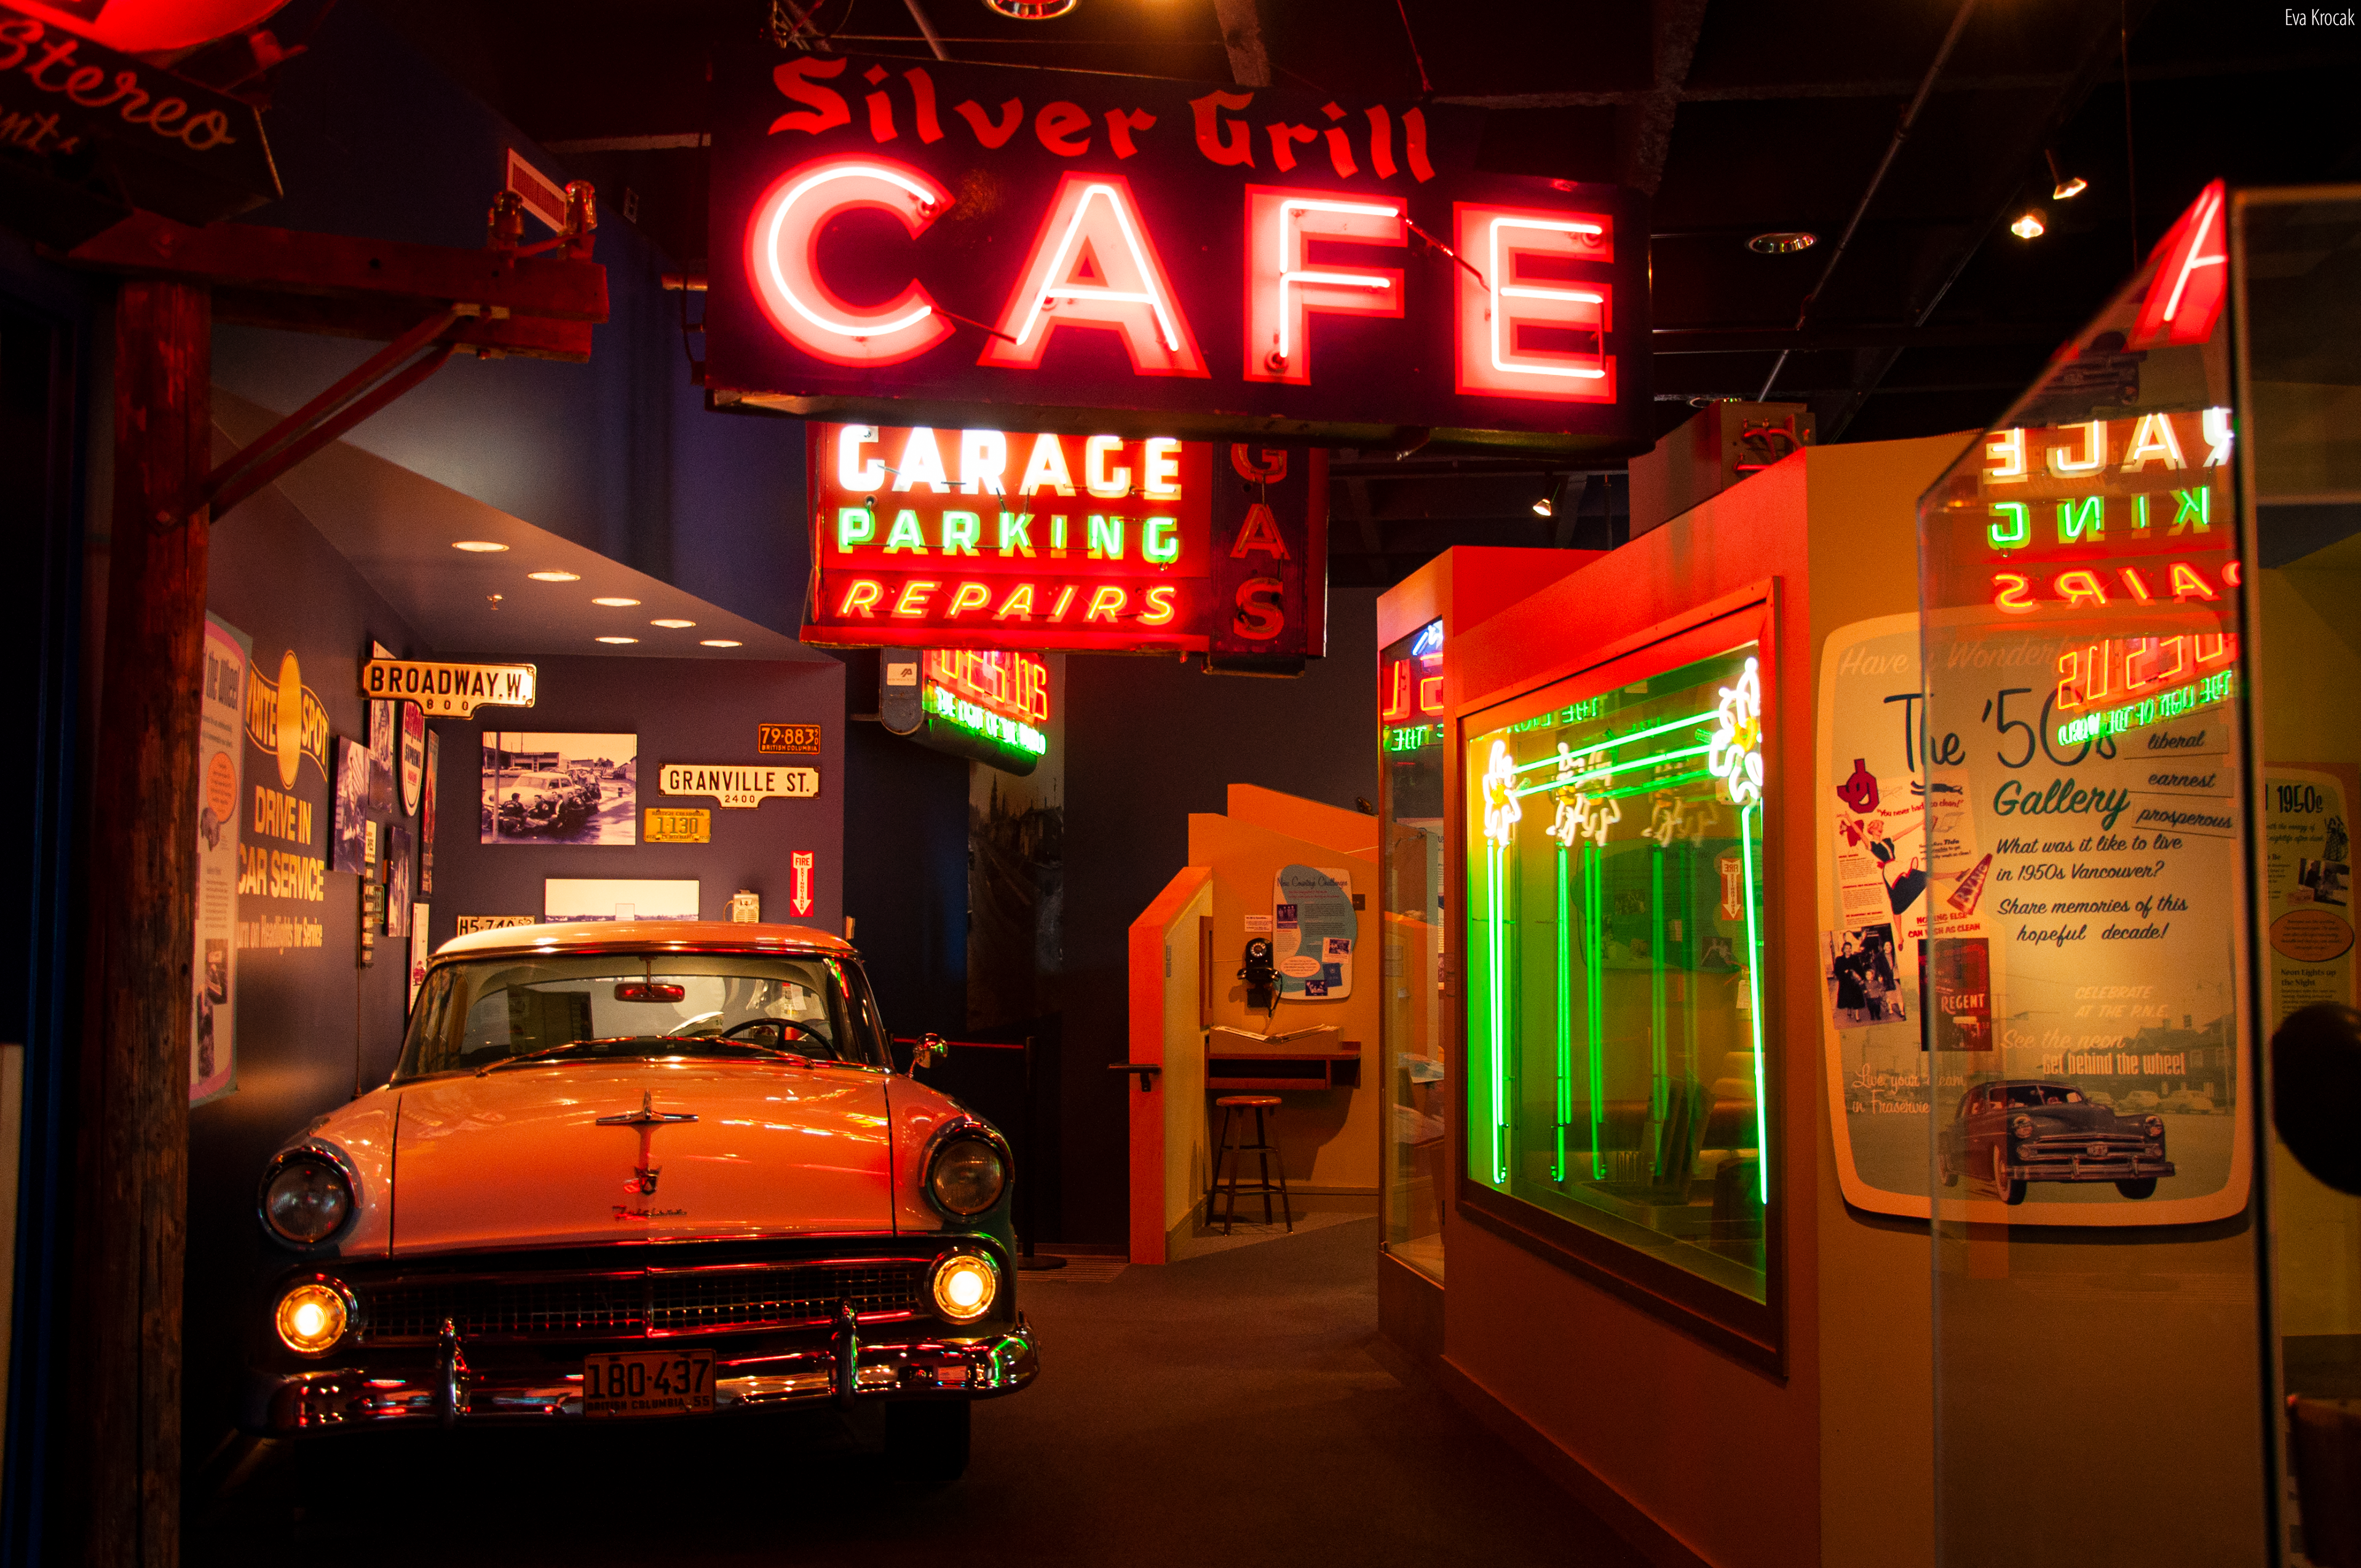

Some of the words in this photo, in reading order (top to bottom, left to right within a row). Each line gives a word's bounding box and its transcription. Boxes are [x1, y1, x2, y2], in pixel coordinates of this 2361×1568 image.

[0, 18, 237, 151] Stereo
[768, 55, 1158, 160] Silver
[1187, 89, 1436, 184] Grill
[744, 152, 1618, 405] CAFE
[837, 424, 1182, 501] GARAGE
[837, 506, 1179, 564] PARKING
[1230, 443, 1290, 641] GAS
[837, 579, 1178, 627] REPAIRS
[1838, 646, 1910, 675] Have
[427, 699, 469, 711] 800
[301, 694, 328, 766] SPOT
[1883, 692, 1966, 773] The
[2147, 729, 2206, 750] liberal
[670, 770, 775, 792] GRANVILLE
[787, 773, 810, 793] ST.
[2147, 772, 2217, 789] earnest
[724, 794, 756, 804] 2400
[1893, 807, 1910, 817] never
[1910, 802, 1924, 812] had
[1993, 777, 2131, 831] Gallery
[2277, 784, 2323, 814] 1950s
[254, 785, 296, 842] DRIVE
[298, 799, 312, 845] IN
[2136, 807, 2234, 830] prosperous
[1996, 836, 2039, 854] What
[2041, 839, 2075, 853] was
[2078, 836, 2092, 852] it
[2096, 834, 2127, 852] like
[2131, 836, 2147, 851] to
[2153, 833, 2182, 850] live
[239, 842, 267, 896] CAR
[271, 849, 325, 902] SERVICE
[795, 857, 810, 866] FIRE
[1996, 867, 2013, 881] in
[2017, 863, 2065, 881] 1950s
[2071, 860, 2165, 879] Vancouver?
[1997, 897, 2047, 915] Share
[2051, 898, 2131, 914] memories
[2135, 895, 2153, 919] of
[2156, 893, 2188, 912] this
[1907, 929, 1923, 938] CAN
[1945, 925, 1956, 934] AS
[1956, 922, 1981, 932] CLEAN
[1916, 913, 1948, 925] NOING
[239, 921, 249, 949] urn
[261, 914, 293, 956] Headlights
[303, 916, 323, 948] Service
[2017, 924, 2087, 947] hopeful
[2101, 922, 2170, 940] decade!
[1941, 992, 1985, 1015] REGENT
[2074, 985, 2154, 1000] CELEBRATE
[2074, 1004, 2094, 1018] AT
[2098, 1004, 2127, 1018] THE
[2001, 1028, 2035, 1049] See
[2041, 1027, 2073, 1049] the
[2078, 1034, 2127, 1050] neon
[2042, 1052, 2065, 1075] Get
[2068, 1052, 2113, 1075] behind
[2116, 1051, 2140, 1075] the
[2143, 1051, 2186, 1075] wheel
[1852, 1063, 1886, 1088] Live
[1890, 1075, 1921, 1095] your
[1852, 1100, 1866, 1113] in
[1871, 1088, 1931, 1115] Fraservie
[587, 1400, 627, 1411] BRITISH
[631, 1398, 683, 1410] COLUMBIA
